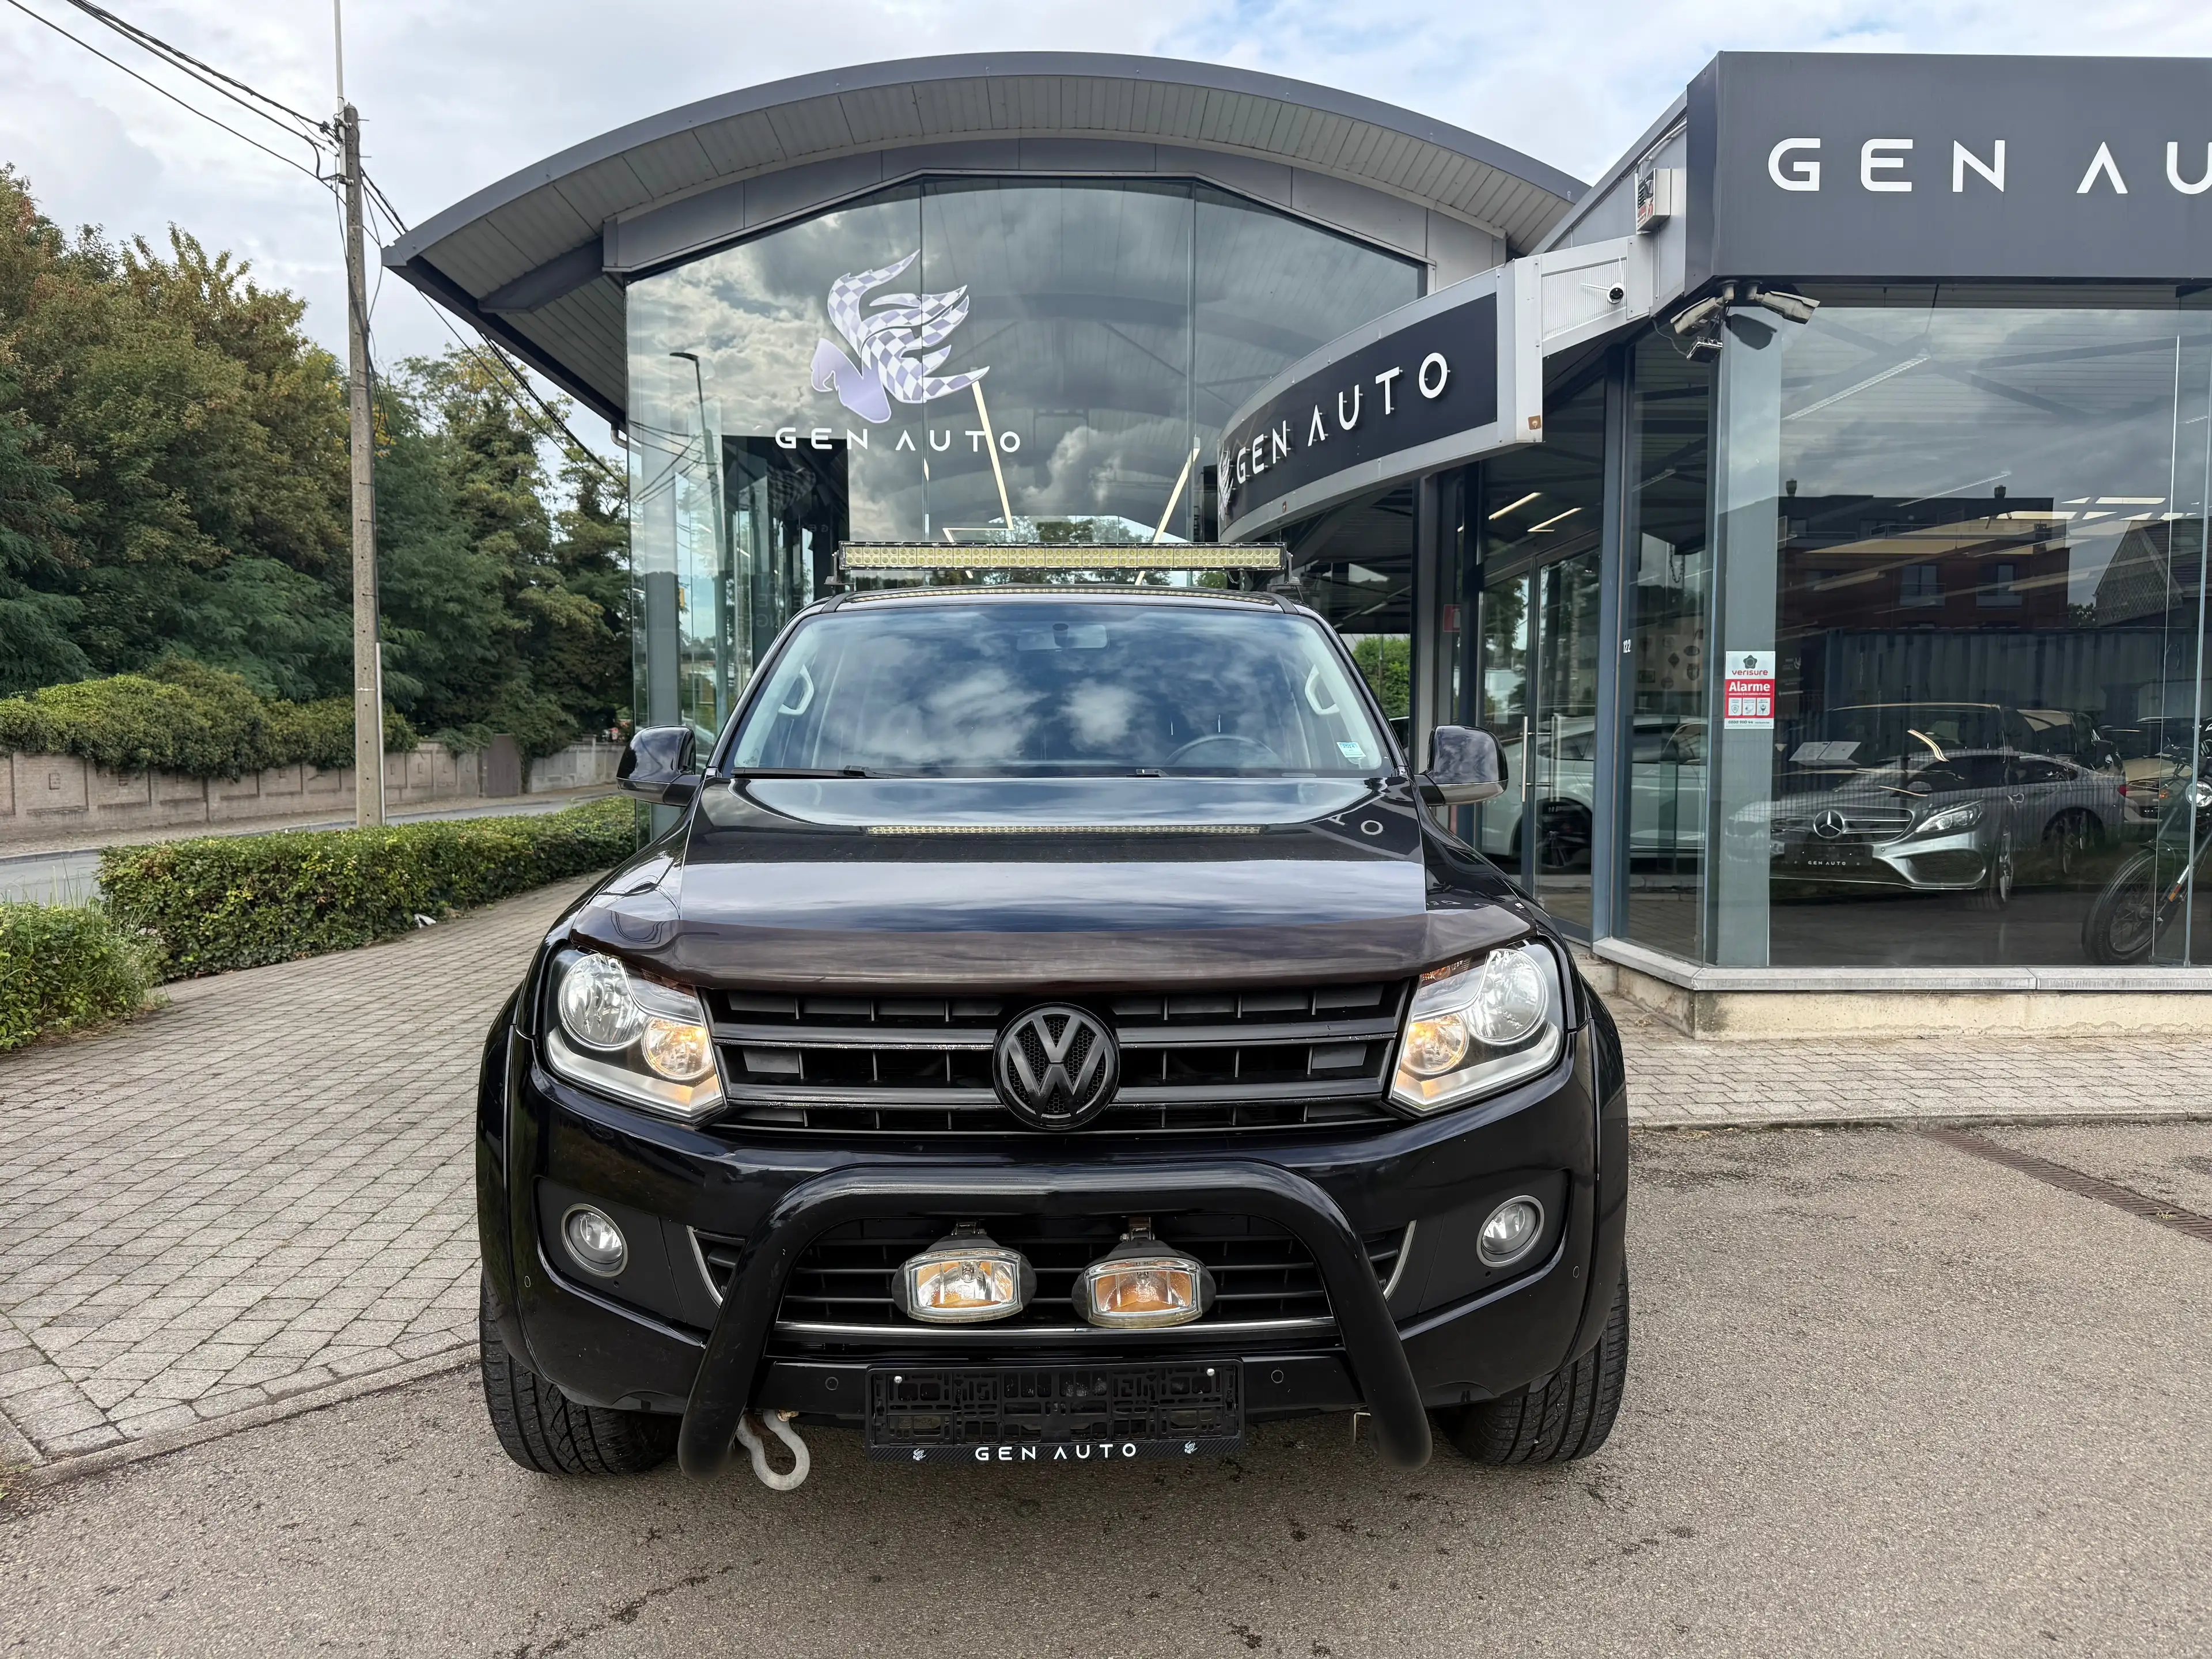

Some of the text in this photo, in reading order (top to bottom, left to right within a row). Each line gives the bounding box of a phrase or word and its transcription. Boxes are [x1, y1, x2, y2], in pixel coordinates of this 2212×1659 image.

[1768, 138, 2005, 192] GEN
[1236, 352, 1448, 484] GEN AUTO
[775, 427, 1021, 453] GEN AUTO
[1729, 681, 1770, 691] Alarme
[975, 1443, 1137, 1461] GEN AUTO
